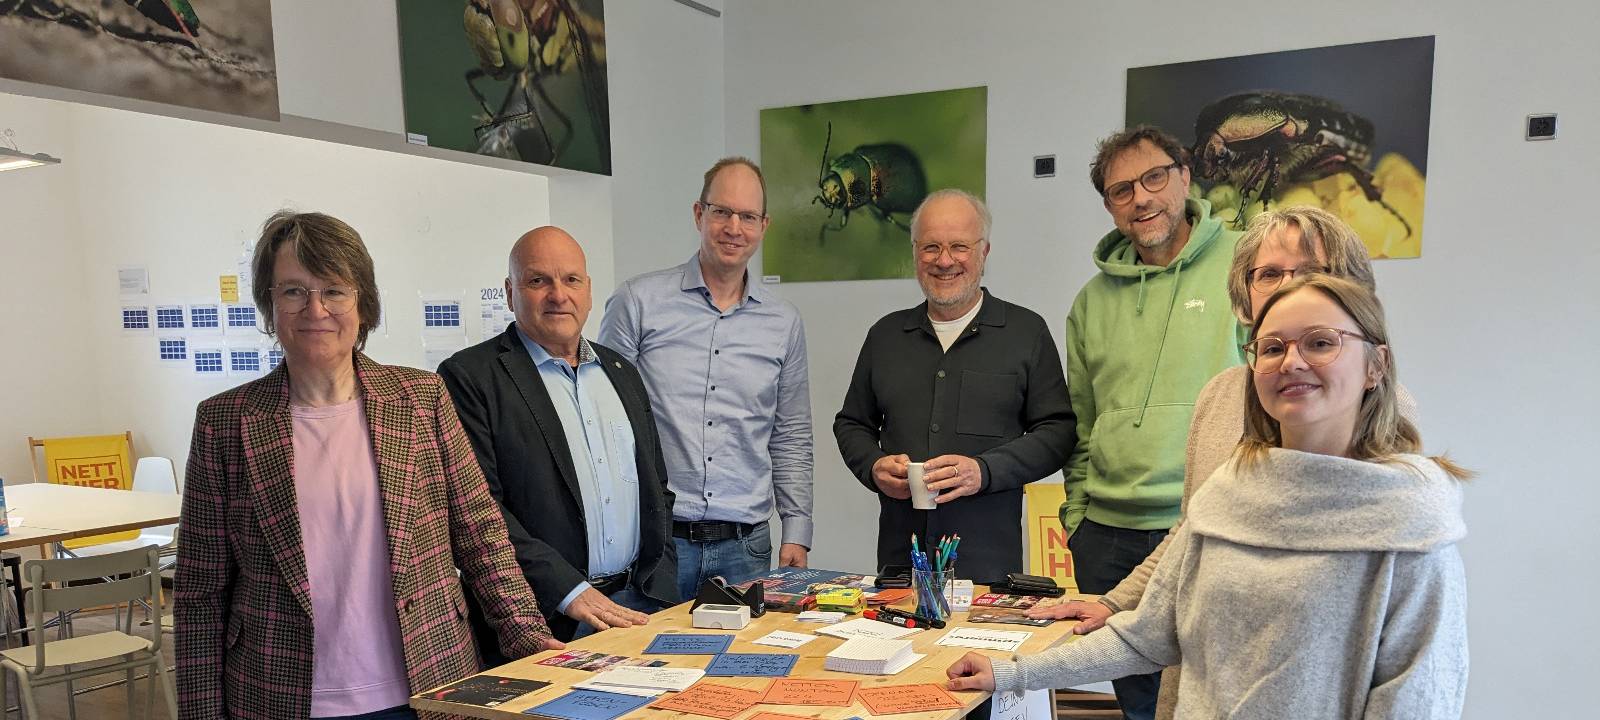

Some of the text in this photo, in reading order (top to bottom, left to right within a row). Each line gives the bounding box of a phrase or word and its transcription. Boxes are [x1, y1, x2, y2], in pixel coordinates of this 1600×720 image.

[480, 287, 504, 300] 2024
[61, 462, 117, 479] NETT
[998, 691, 1025, 714] DEIN
